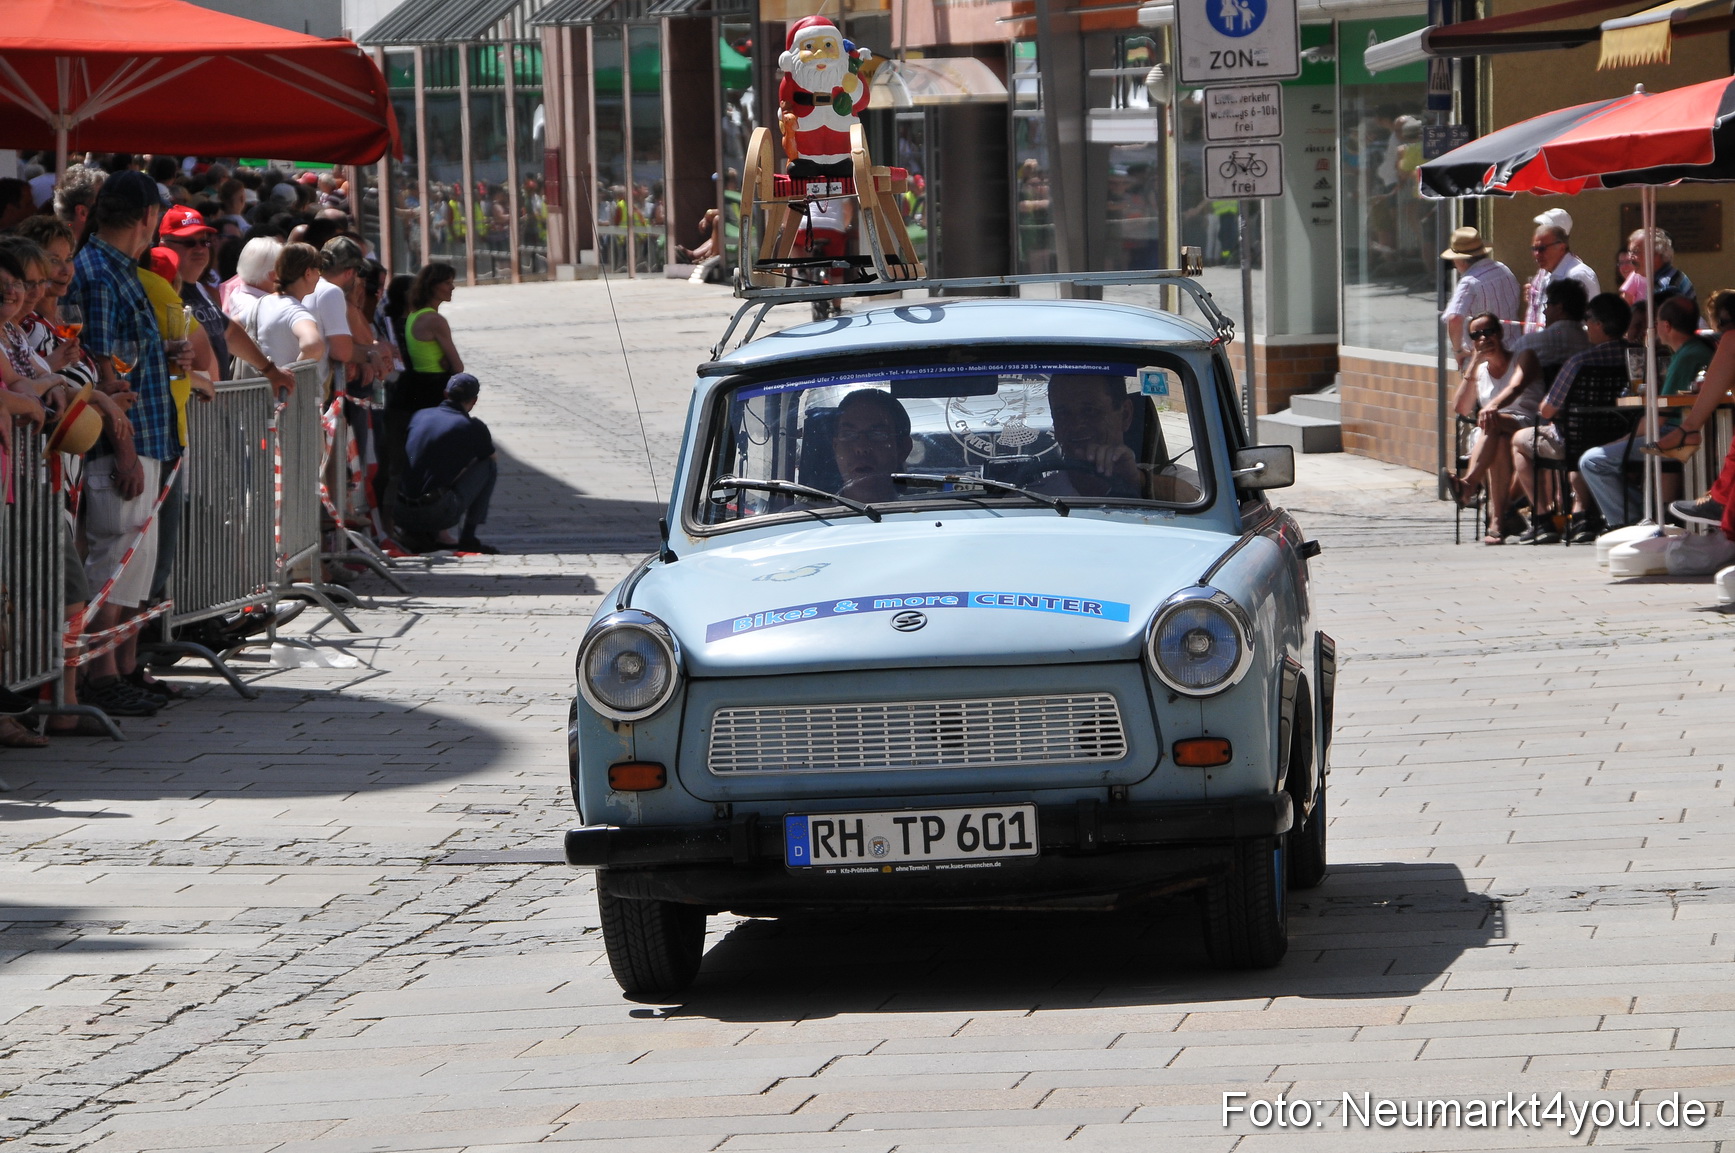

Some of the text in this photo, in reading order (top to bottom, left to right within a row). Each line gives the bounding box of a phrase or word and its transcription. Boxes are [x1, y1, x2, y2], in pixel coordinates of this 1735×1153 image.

[1235, 121, 1254, 132] frei
[1232, 180, 1256, 193] frei
[855, 371, 885, 379] Innsbruck
[918, 366, 935, 374] 0512
[968, 363, 988, 371] Mobil:
[1041, 363, 1110, 371] www.bikesandmore.at
[732, 593, 1103, 633] Bikes & more CENTER
[811, 818, 865, 859] RH
[893, 814, 946, 856] TP
[956, 811, 1033, 853] 601
[794, 845, 803, 857] D
[935, 861, 1002, 870] www.kues-muenchen.de
